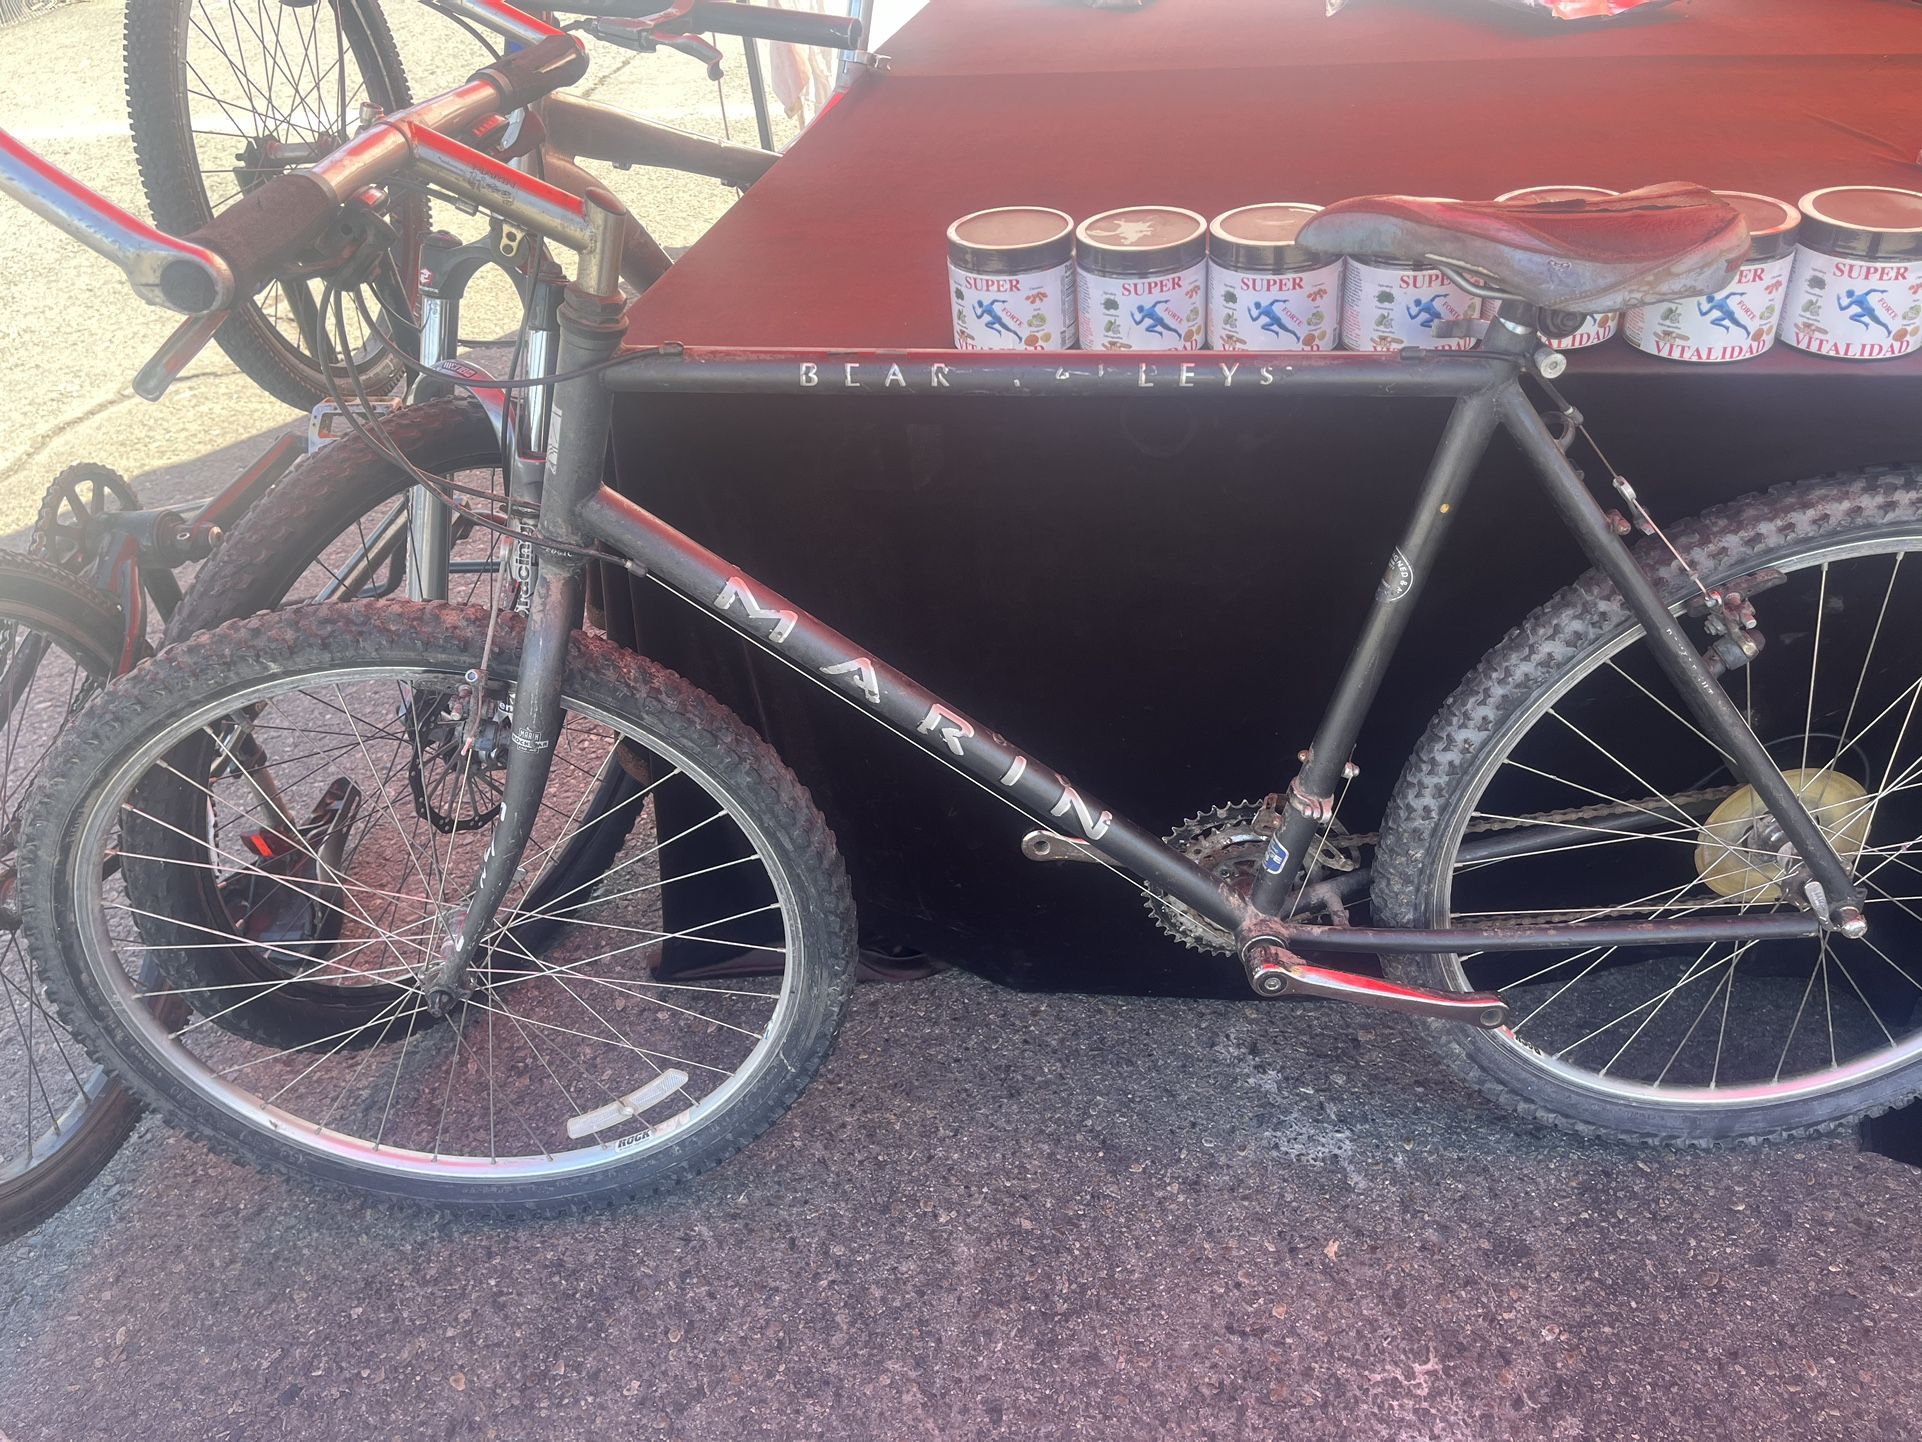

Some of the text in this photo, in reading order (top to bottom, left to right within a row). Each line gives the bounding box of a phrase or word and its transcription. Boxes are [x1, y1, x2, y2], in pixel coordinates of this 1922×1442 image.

[1400, 272, 1452, 289] SUPE
[1833, 262, 1909, 281] SUPER
[965, 276, 1021, 293] SUPER
[1122, 276, 1182, 297] SUPER
[1241, 276, 1304, 293] SUPER
[1001, 306, 1024, 328] FORTE
[1163, 306, 1184, 325] FORTE
[1282, 306, 1303, 328] FORTE
[1737, 299, 1757, 322] FORTE
[1878, 297, 1899, 320] FORTE
[1654, 339, 1766, 361] VITALIDAD
[1794, 331, 1911, 357] VITALIDAD
[800, 362, 950, 387] BEAR
[714, 576, 1113, 840] MARIN
[617, 1129, 651, 1149] ROCK
